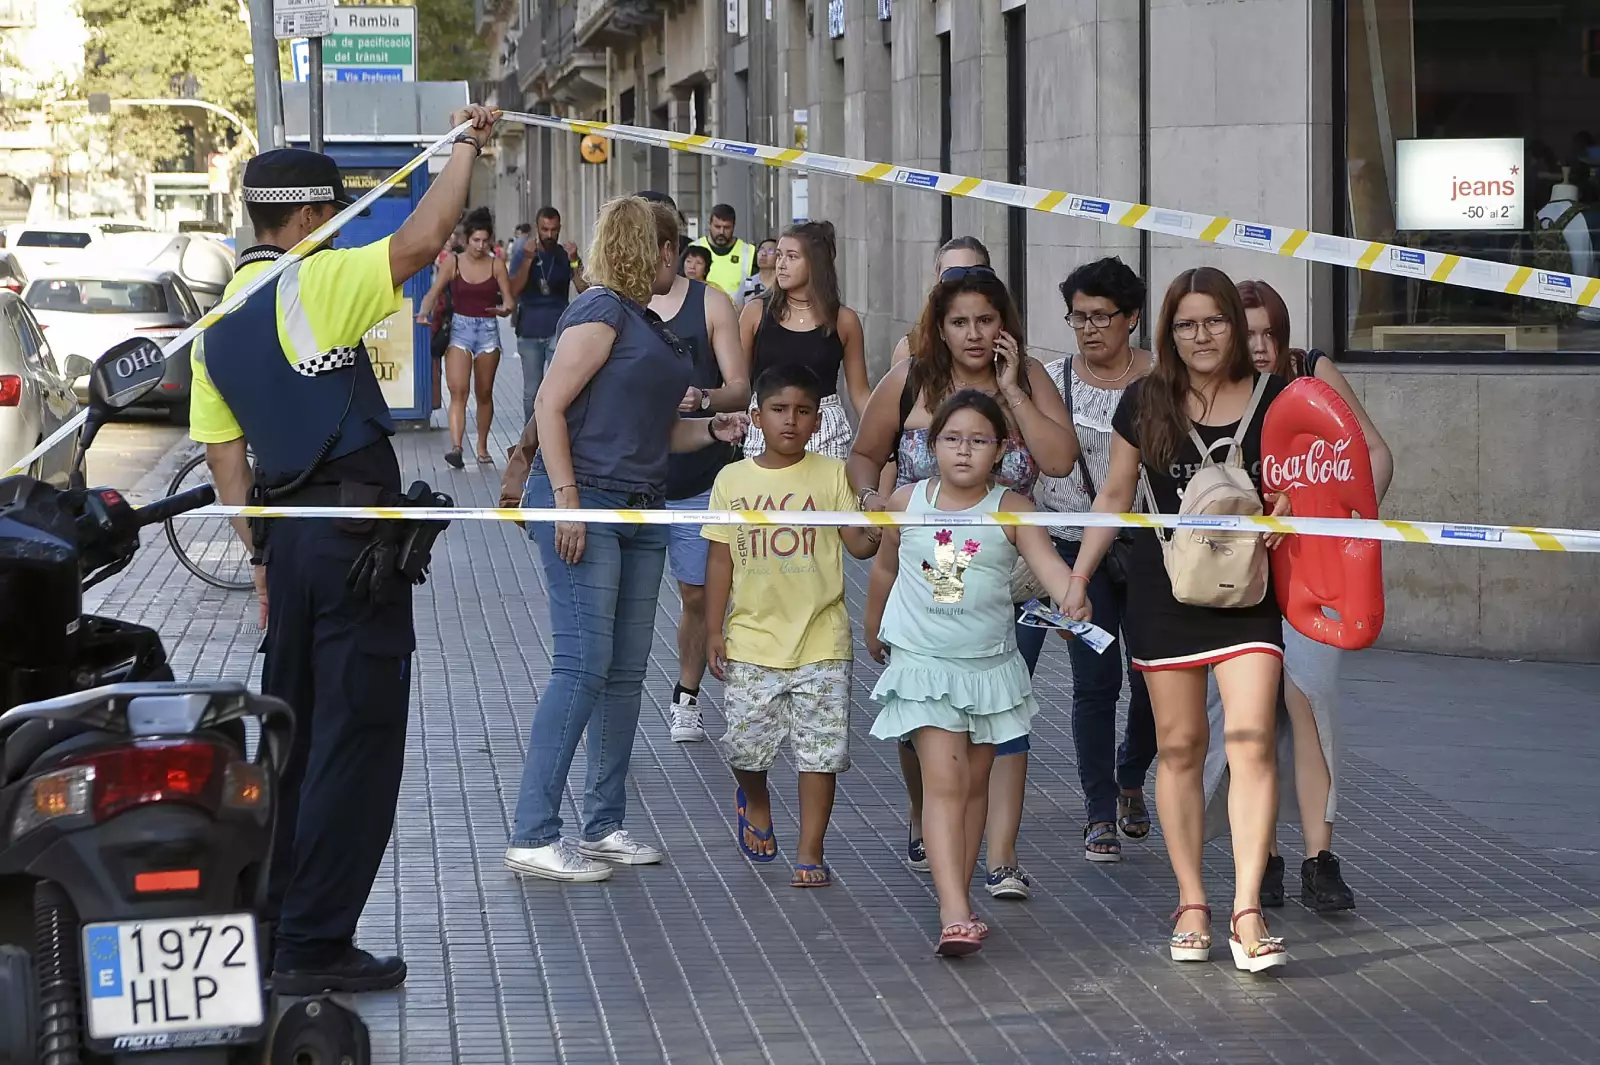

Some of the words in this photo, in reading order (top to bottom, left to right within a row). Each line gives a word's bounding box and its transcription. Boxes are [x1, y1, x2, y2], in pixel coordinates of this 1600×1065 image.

[349, 14, 400, 28] Rambla
[341, 37, 353, 48] de
[358, 35, 410, 50] pacificació
[335, 53, 350, 63] del
[1263, 436, 1352, 491] Coca-Cola
[131, 925, 247, 973] 1972
[99, 968, 115, 987] E
[130, 975, 218, 1024] HLP
